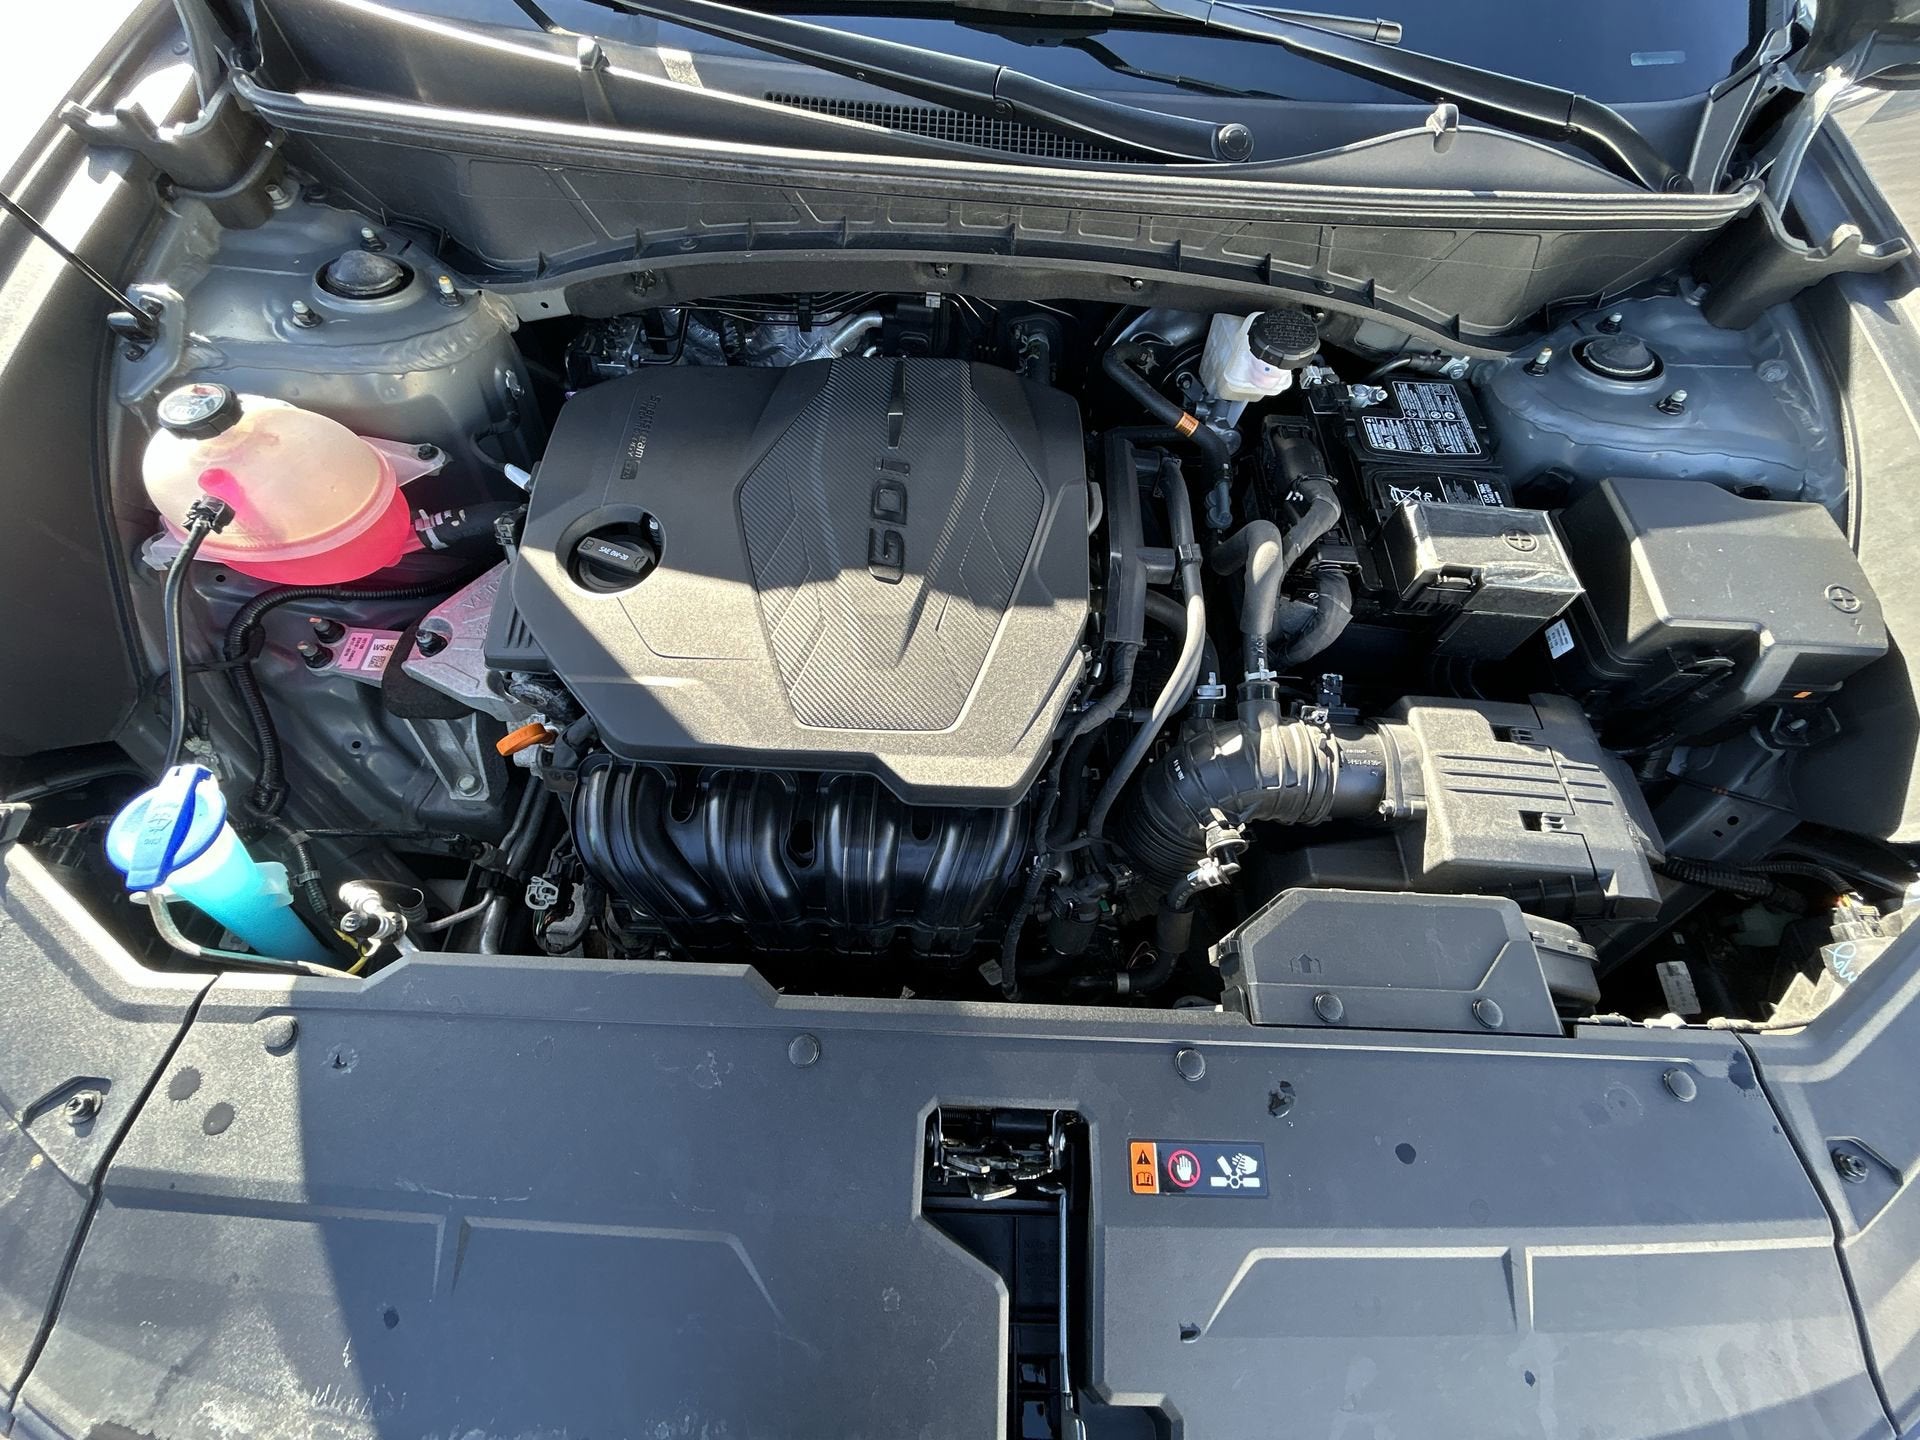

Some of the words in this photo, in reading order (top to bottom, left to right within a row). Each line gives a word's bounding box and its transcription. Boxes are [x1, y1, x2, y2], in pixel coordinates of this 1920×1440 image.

[635, 395, 661, 458] Smartstream
[599, 546, 611, 555] SAE
[610, 550, 629, 561] 0W-20
